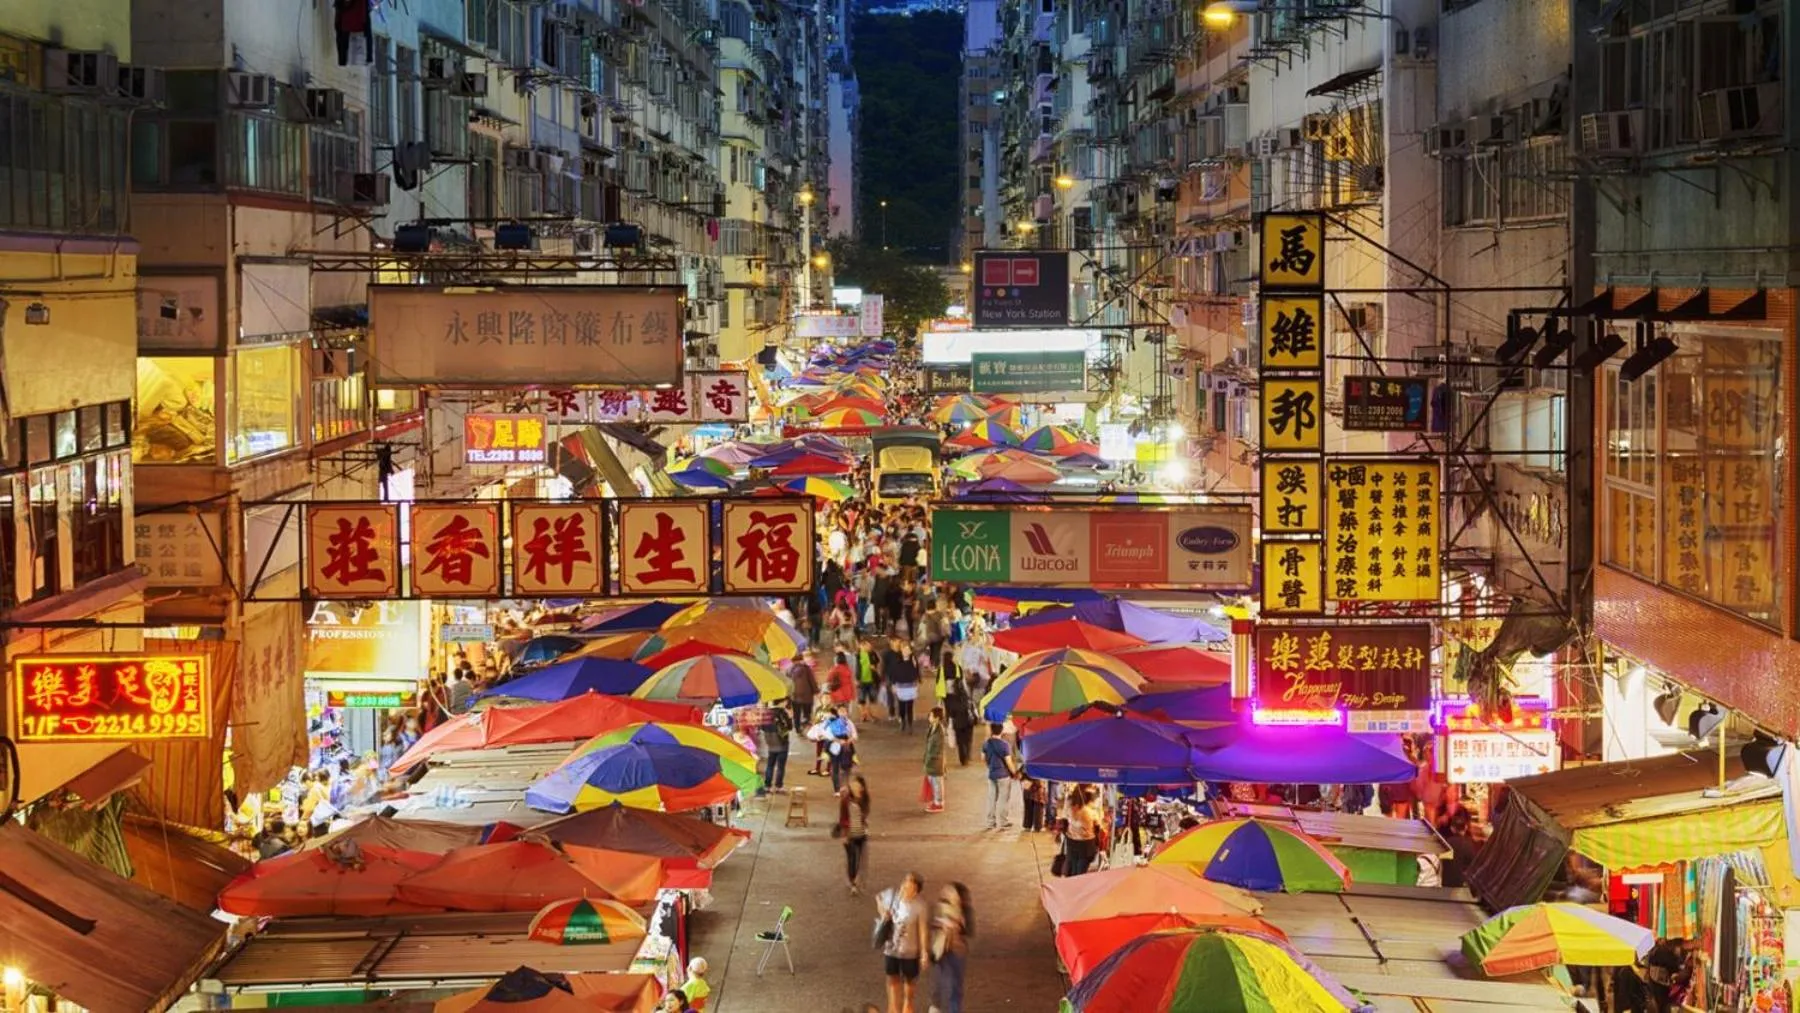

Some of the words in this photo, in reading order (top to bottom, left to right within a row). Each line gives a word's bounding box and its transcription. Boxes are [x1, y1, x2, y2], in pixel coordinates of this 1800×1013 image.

[982, 308, 1002, 318] New
[1006, 308, 1026, 318] York
[1028, 308, 1062, 318] Station
[943, 544, 1001, 572] LEONA
[1104, 543, 1154, 560] Triumph
[1021, 556, 1079, 572] Wacoal
[311, 629, 400, 640] PROFESSIONA
[1372, 692, 1409, 708] Design
[24, 715, 61, 734] 1/F
[94, 714, 145, 733] 2214
[151, 714, 201, 732] 9995
